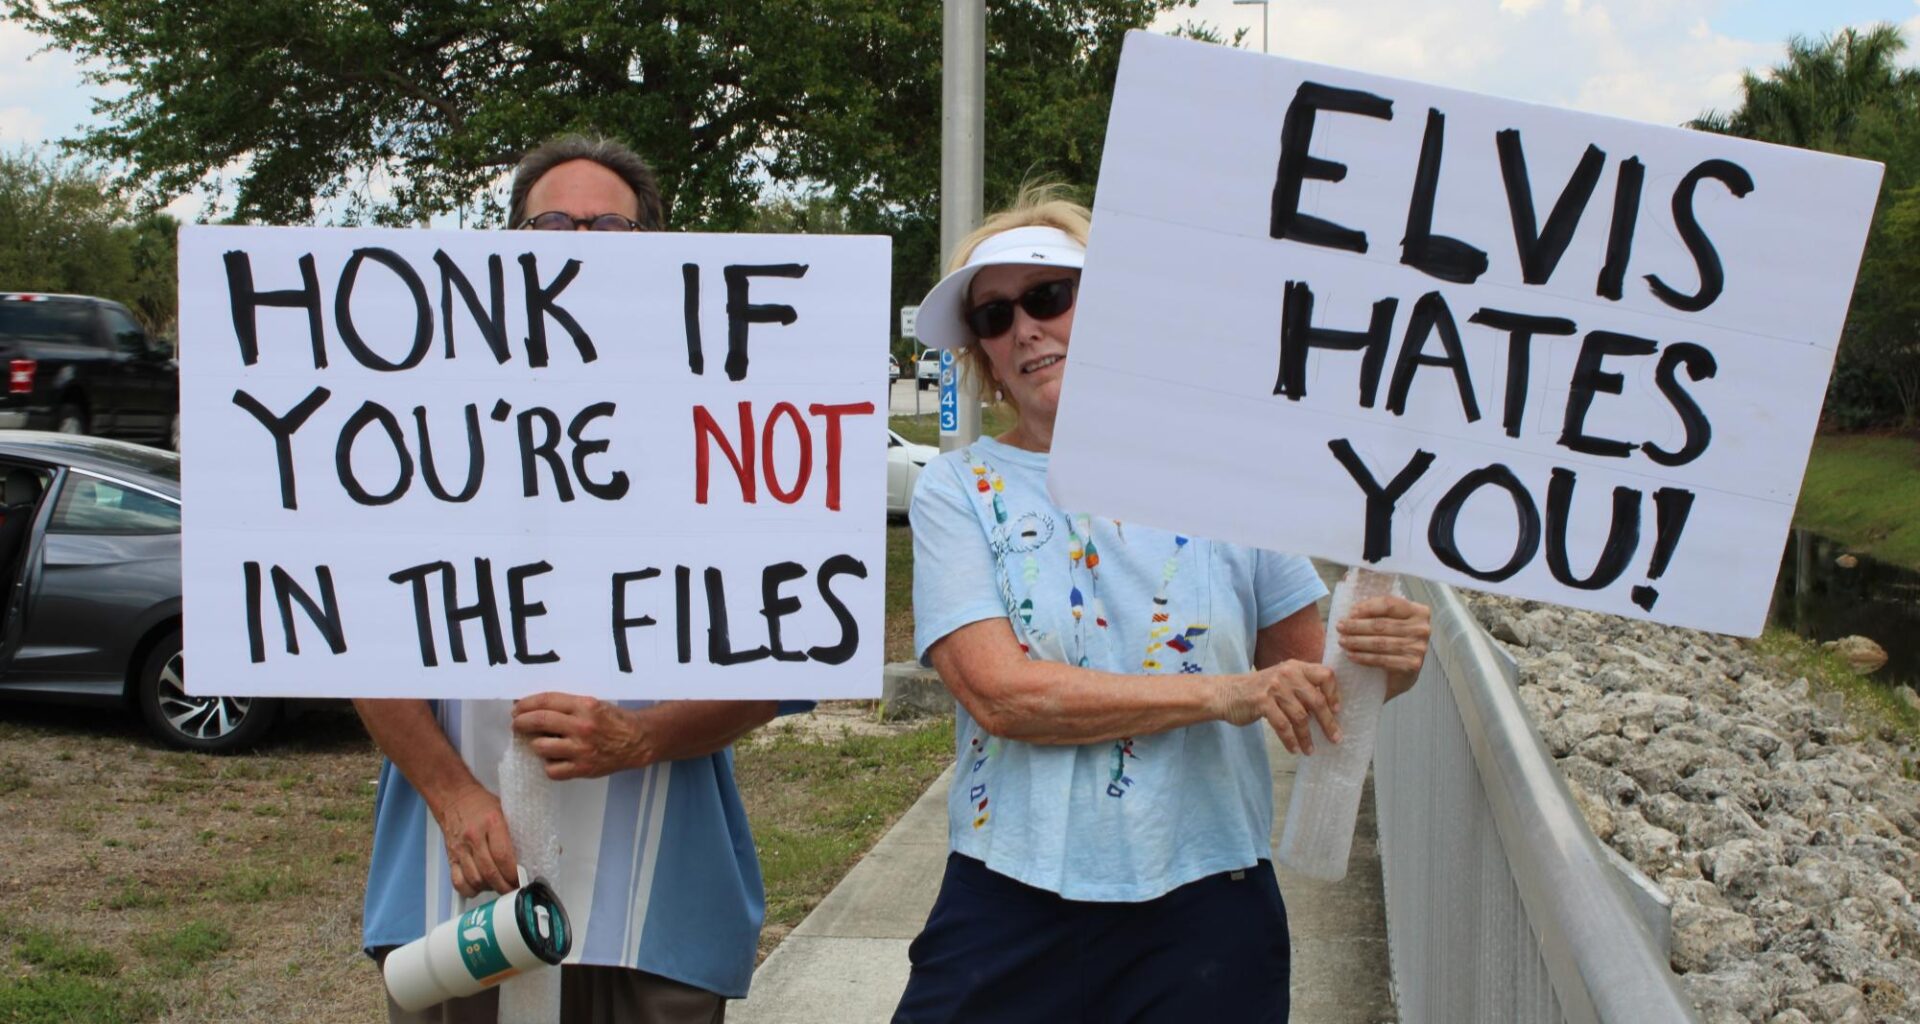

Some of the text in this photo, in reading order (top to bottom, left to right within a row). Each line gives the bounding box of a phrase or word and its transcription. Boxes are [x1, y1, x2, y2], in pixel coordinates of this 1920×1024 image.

[1270, 81, 1755, 313] ELVIS
[223, 247, 809, 382] HONK IF
[1272, 280, 1718, 467] HATES
[232, 387, 875, 511] YOU'RE NOT
[1328, 438, 1696, 611] YOU!
[244, 554, 868, 673] IN THE FILES
